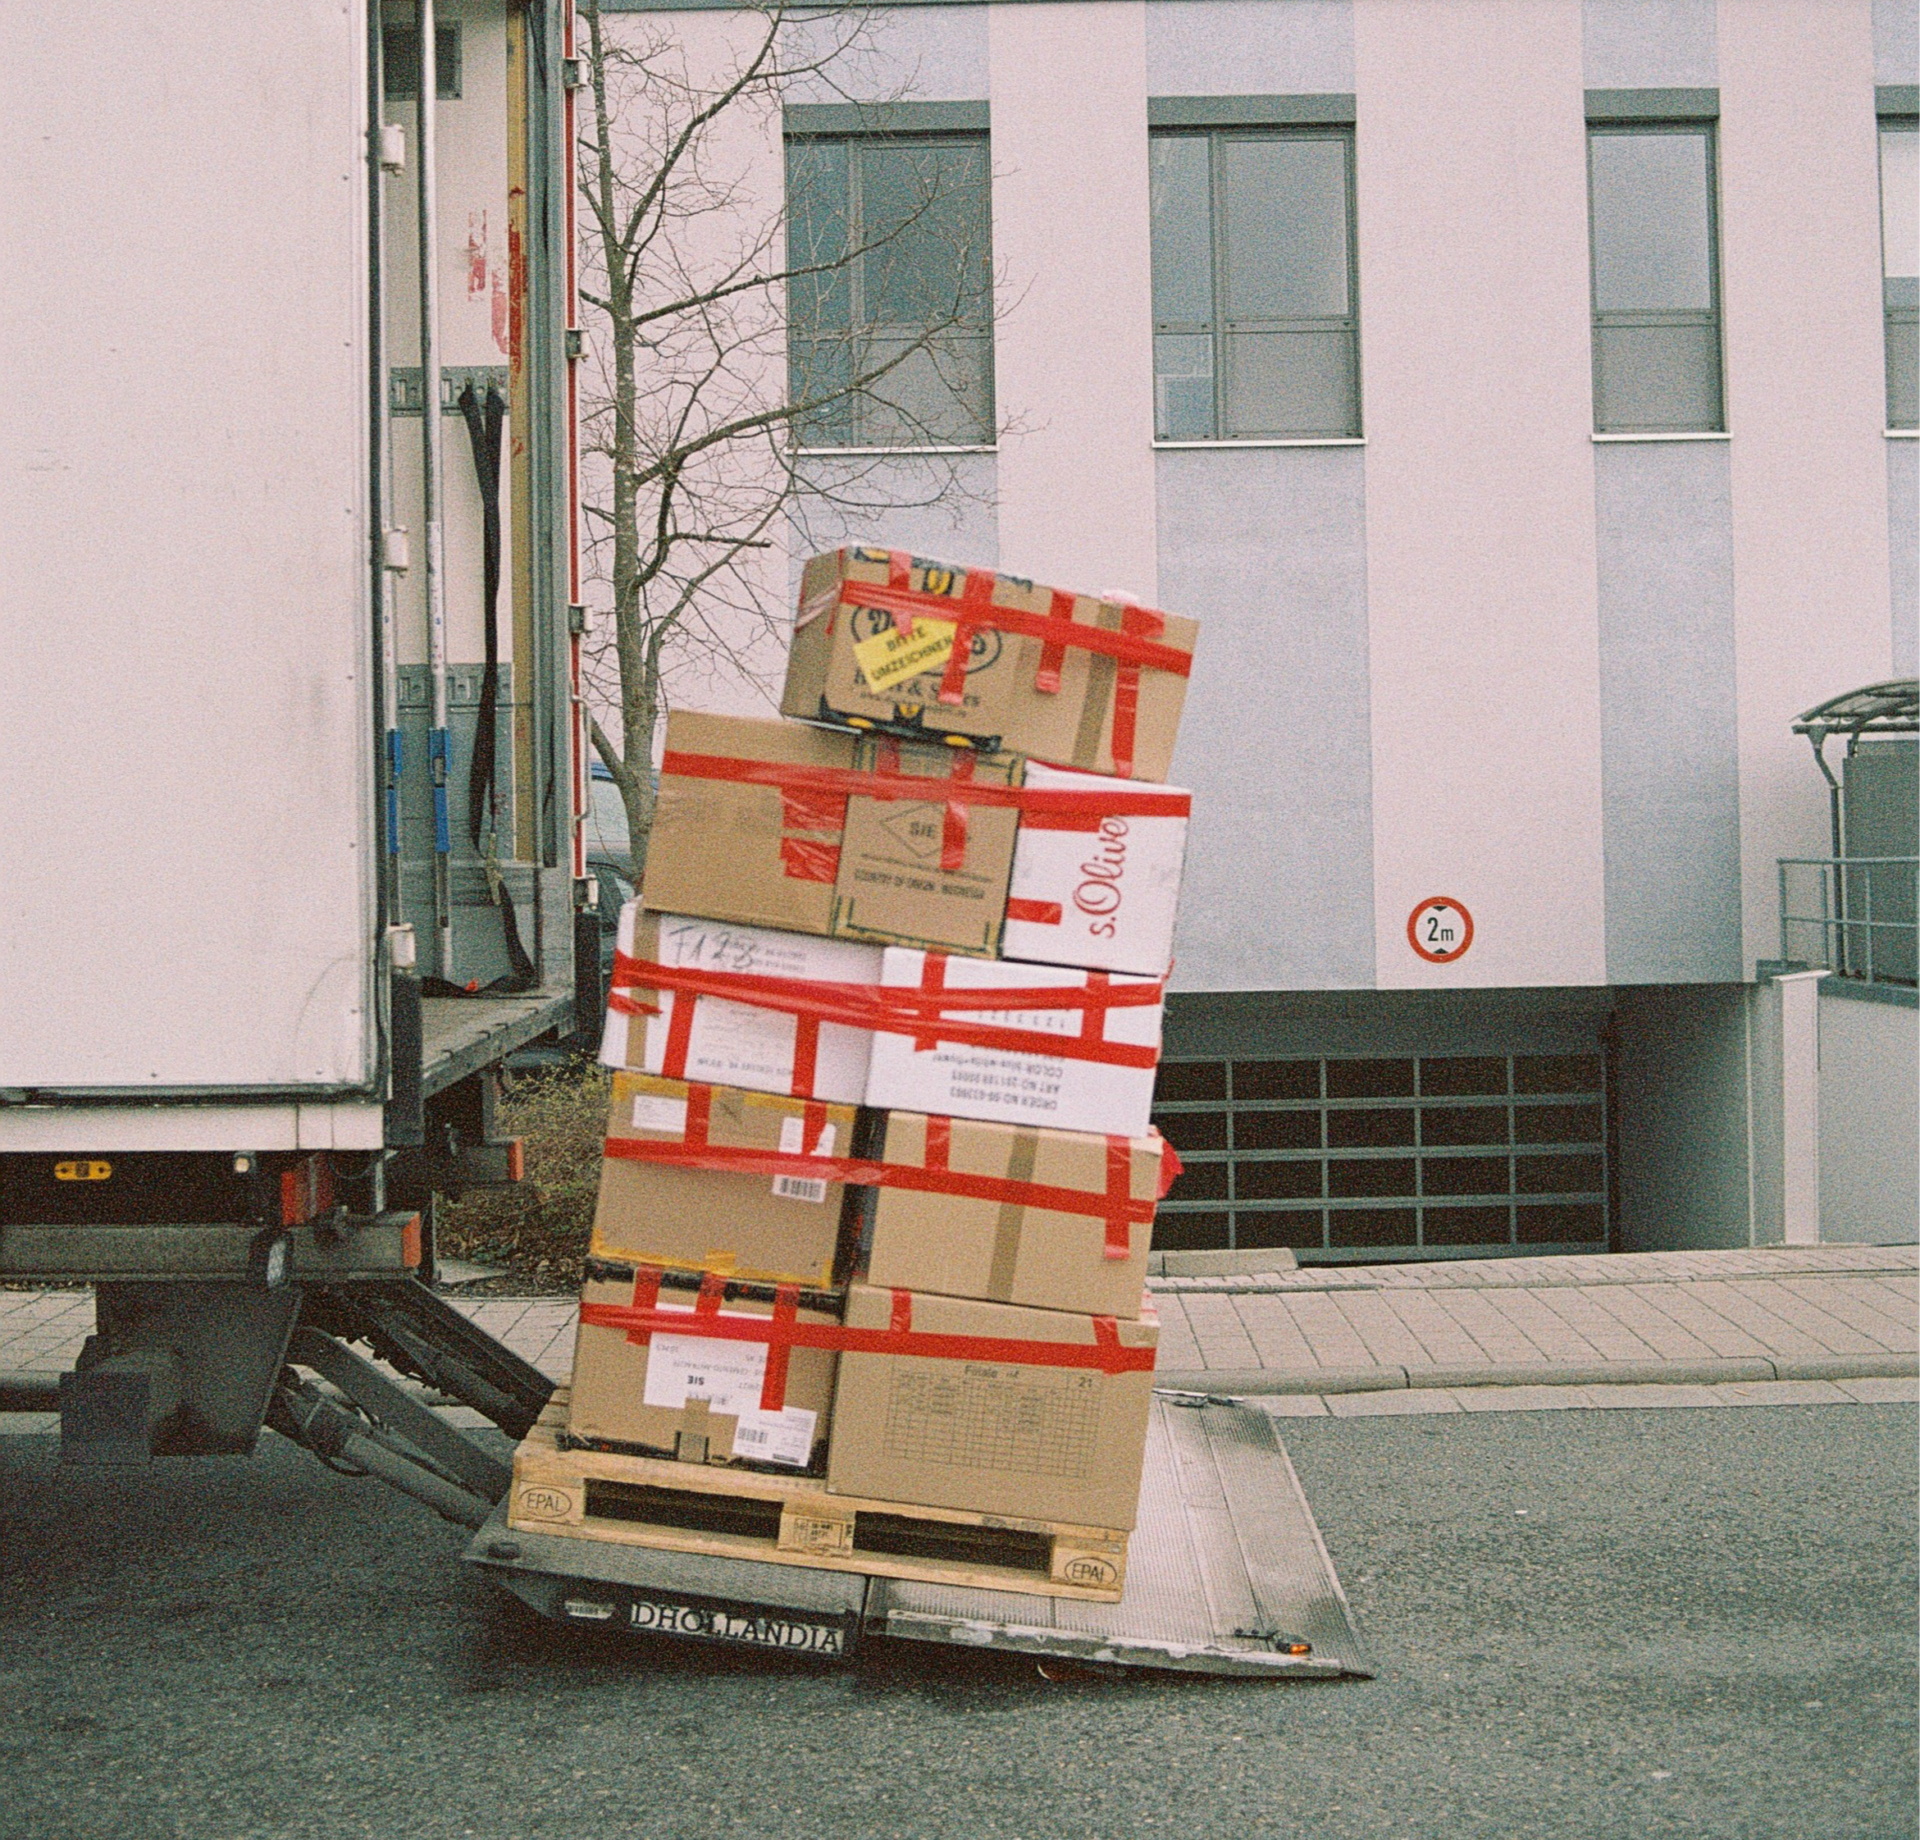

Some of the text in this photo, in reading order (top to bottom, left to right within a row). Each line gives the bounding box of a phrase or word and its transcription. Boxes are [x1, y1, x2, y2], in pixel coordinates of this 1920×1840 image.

[885, 625, 926, 651] BITTE
[1073, 816, 1129, 939] s.Olive
[687, 1375, 705, 1386] SIE
[526, 1492, 562, 1513] EPAL
[632, 1601, 841, 1652] DHOLLANDIA
